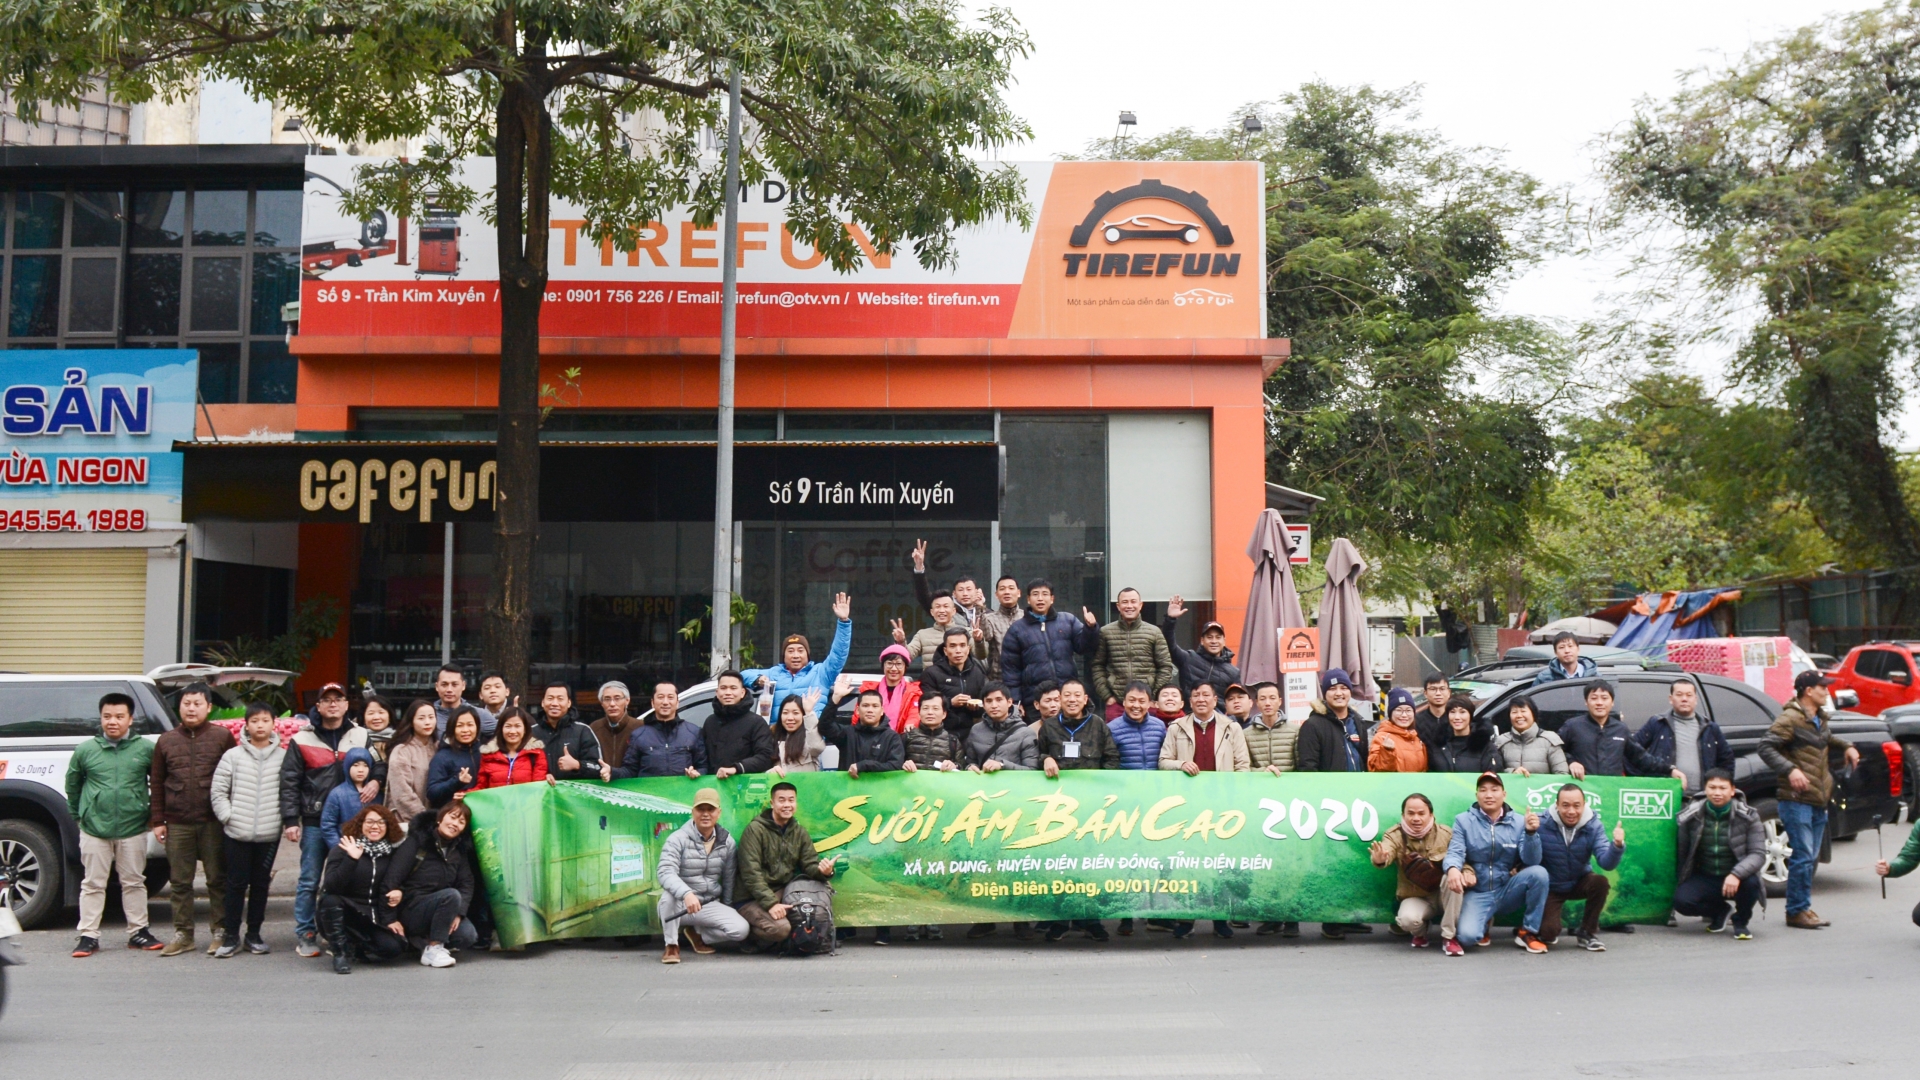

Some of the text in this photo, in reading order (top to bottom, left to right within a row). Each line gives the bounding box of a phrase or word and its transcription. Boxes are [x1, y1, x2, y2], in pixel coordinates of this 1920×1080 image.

[1063, 253, 1242, 277] TIREFUN
[317, 286, 338, 303] Số
[341, 288, 351, 303] 9
[365, 285, 398, 303] Trần
[403, 287, 432, 303] Kim
[437, 286, 485, 306] Xuyến
[542, 290, 561, 303] ne:
[566, 289, 601, 304] 0901
[606, 289, 633, 304] 756
[638, 290, 664, 304] 226
[677, 290, 724, 305] Email:
[736, 290, 840, 308] irefun@otv.vn
[857, 291, 923, 306] Website:
[927, 293, 1000, 306] tirefun.vn
[1067, 297, 1081, 307] Một
[1083, 298, 1097, 306] sản
[1098, 296, 1120, 308] phẩm
[1121, 297, 1136, 306] của
[1155, 297, 1170, 306] đàn
[3, 367, 151, 435] SẢN
[56, 458, 147, 484] NGON
[769, 477, 954, 511] Số 9 Trần Kim Xuyến
[1286, 651, 1315, 659] TIREFUN
[15, 764, 26, 774] Sa
[26, 764, 47, 777] Dung
[1623, 791, 1669, 805] OTV
[1258, 797, 1379, 842] 2020
[1623, 804, 1671, 817] MEDIA
[903, 850, 1273, 876] XÃ XA DUNG, HUYỆN ĐIỆN BIÊN ĐÔNG, TỈNH ĐIỆN BIÊN
[971, 878, 1199, 900] Điện Biên Đông, 09/01/2021
